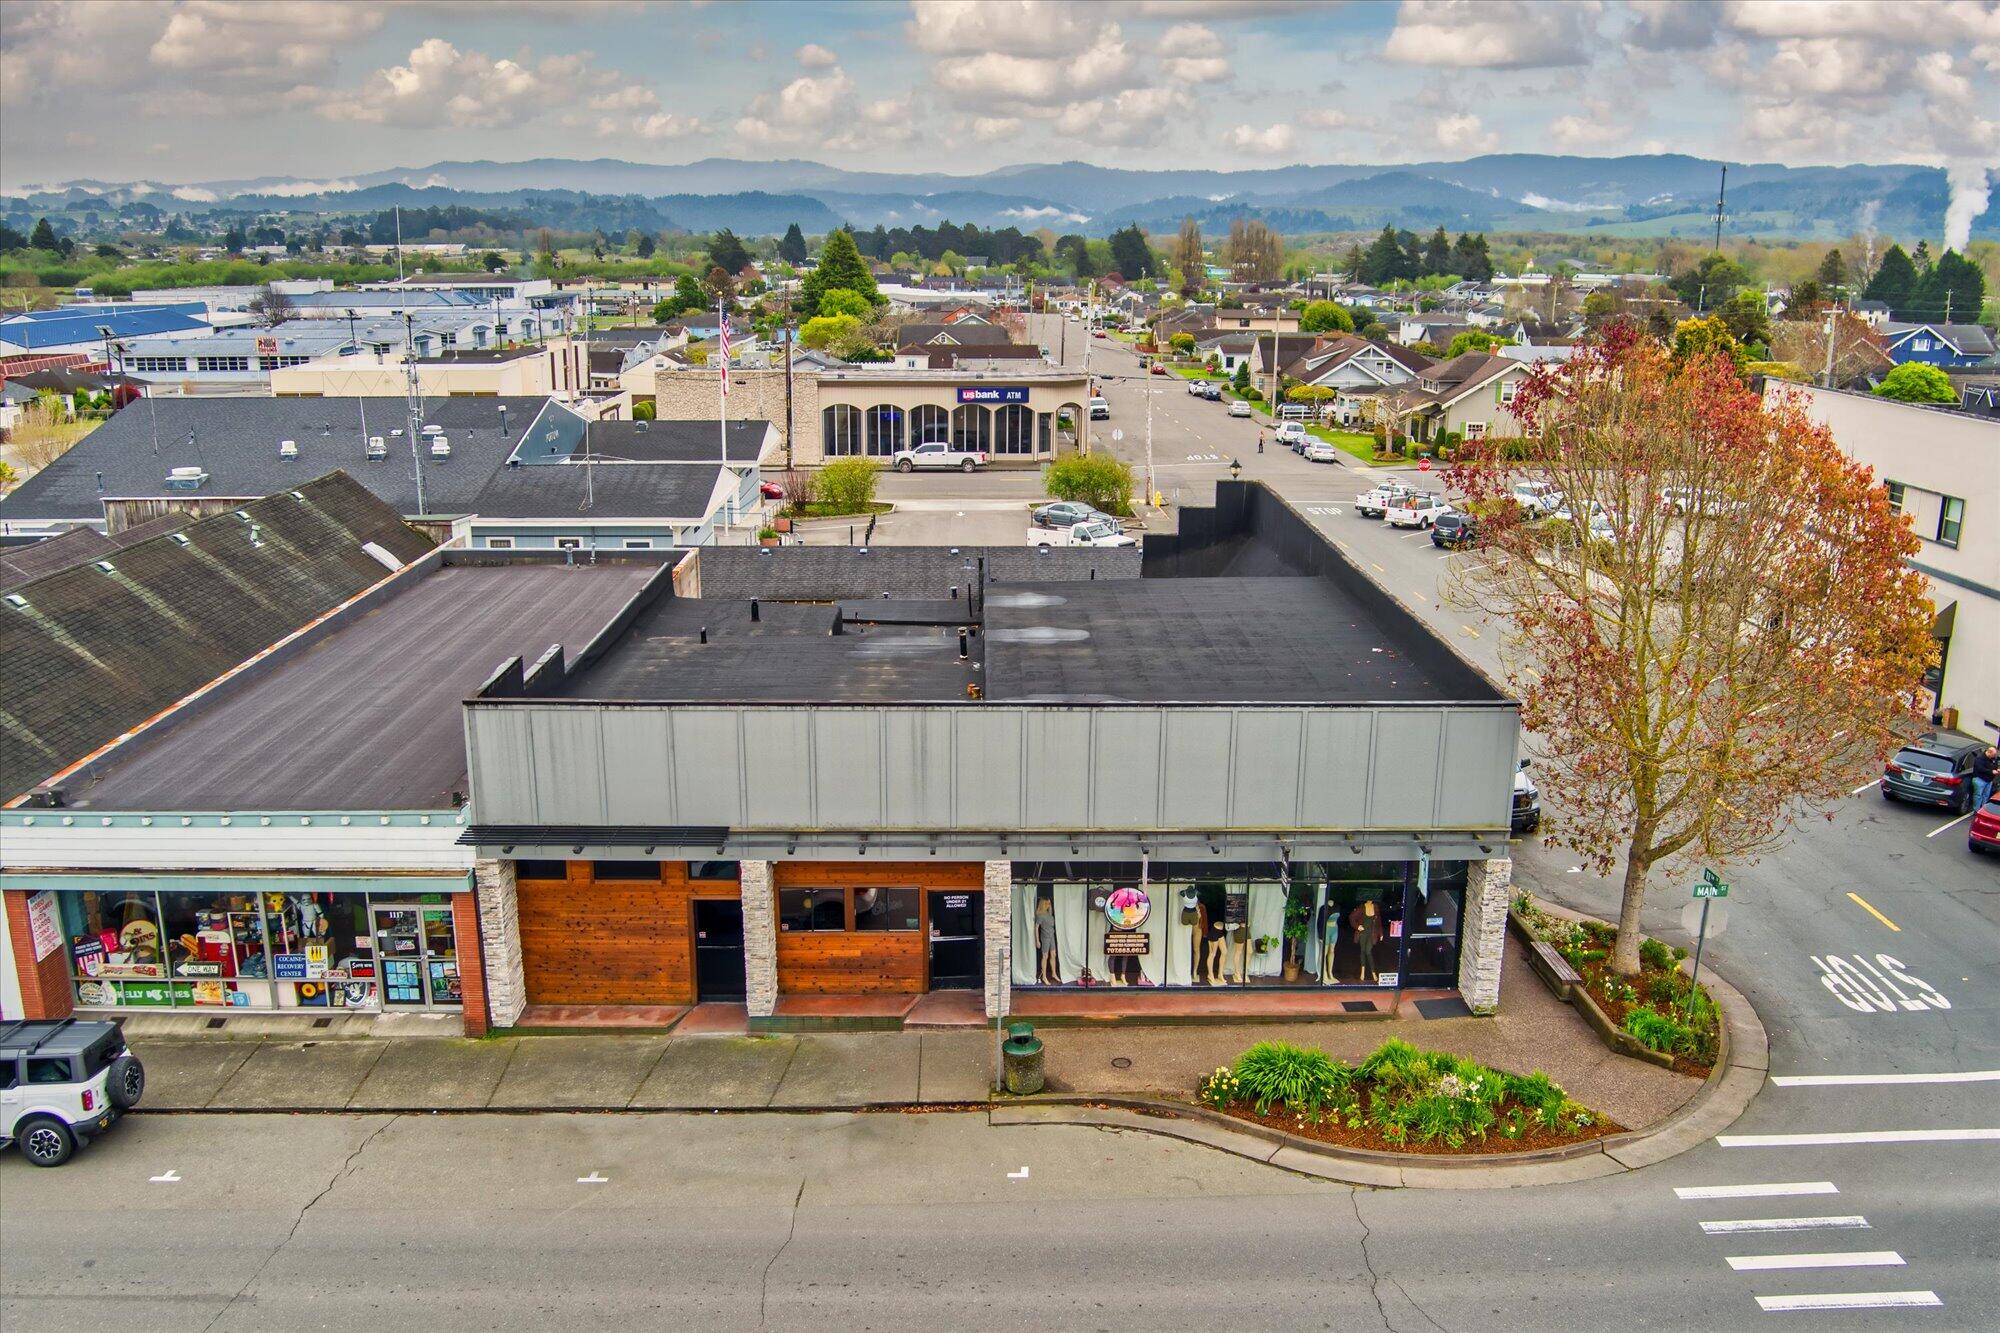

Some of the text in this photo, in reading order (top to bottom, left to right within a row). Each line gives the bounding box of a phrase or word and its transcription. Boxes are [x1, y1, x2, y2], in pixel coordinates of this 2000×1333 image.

[1006, 391, 1021, 400] ATM
[1306, 507, 1343, 515] STOP
[1697, 887, 1718, 896] MAIN
[389, 911, 404, 919] 1117
[1810, 953, 1952, 1012] STOP
